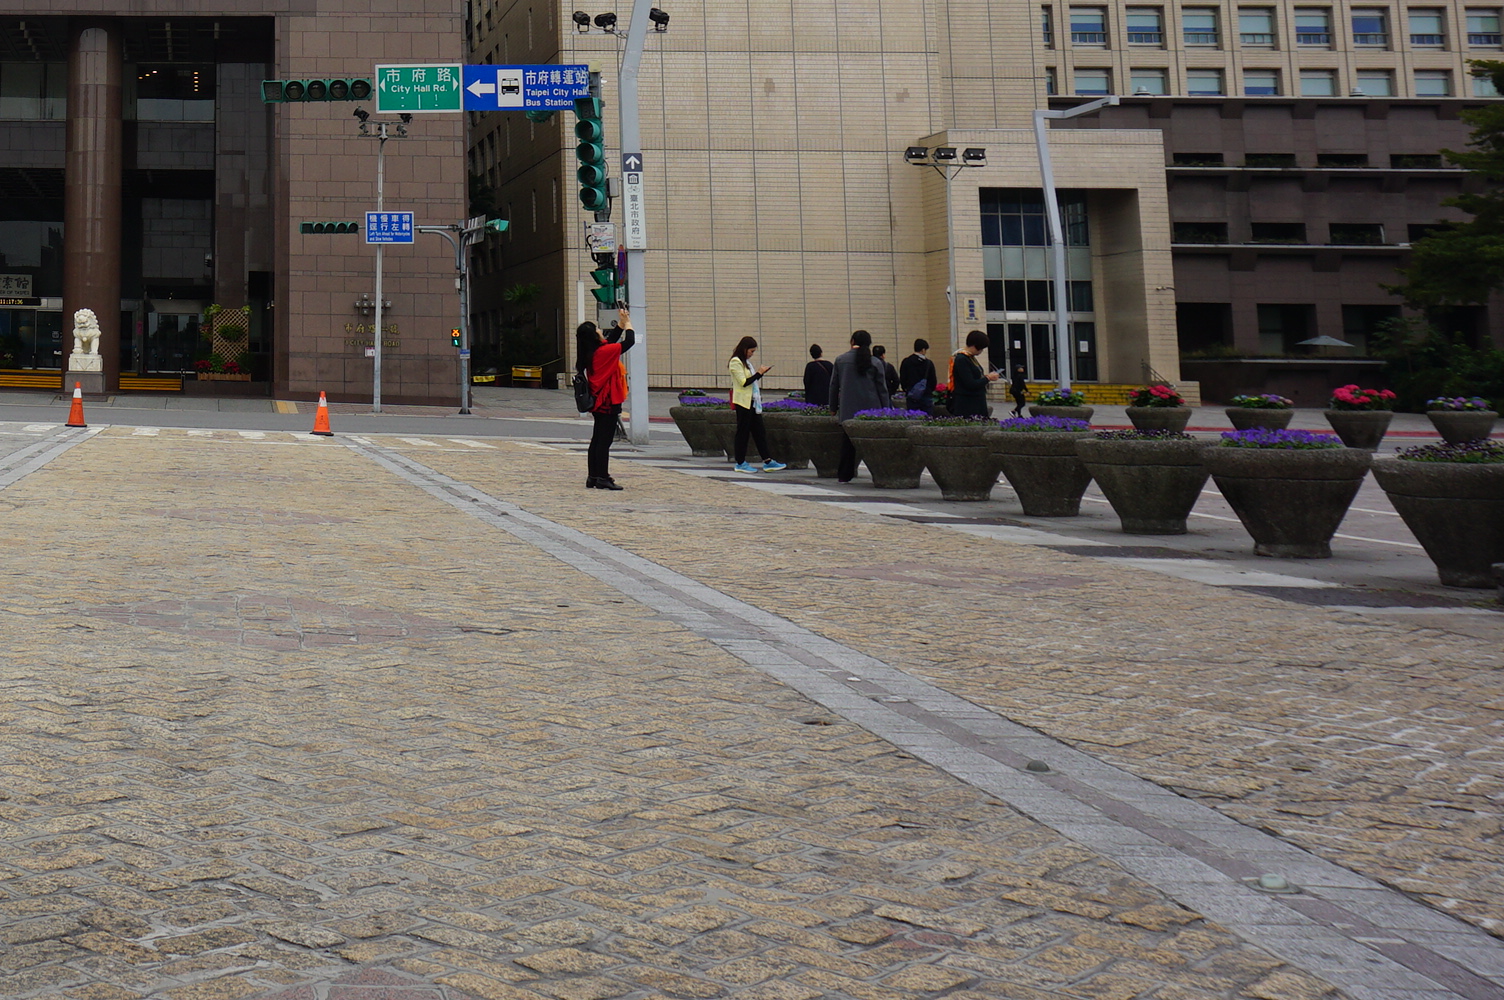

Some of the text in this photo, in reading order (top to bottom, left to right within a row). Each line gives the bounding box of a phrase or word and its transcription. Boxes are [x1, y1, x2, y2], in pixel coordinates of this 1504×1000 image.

[386, 68, 451, 83] 市府路
[526, 69, 589, 85] 市府轉運站
[391, 84, 448, 94] City Hall Rd.
[526, 88, 588, 97] Taipei City Hall
[526, 98, 573, 106] Bus Station
[630, 195, 640, 235] 臺北市政府
